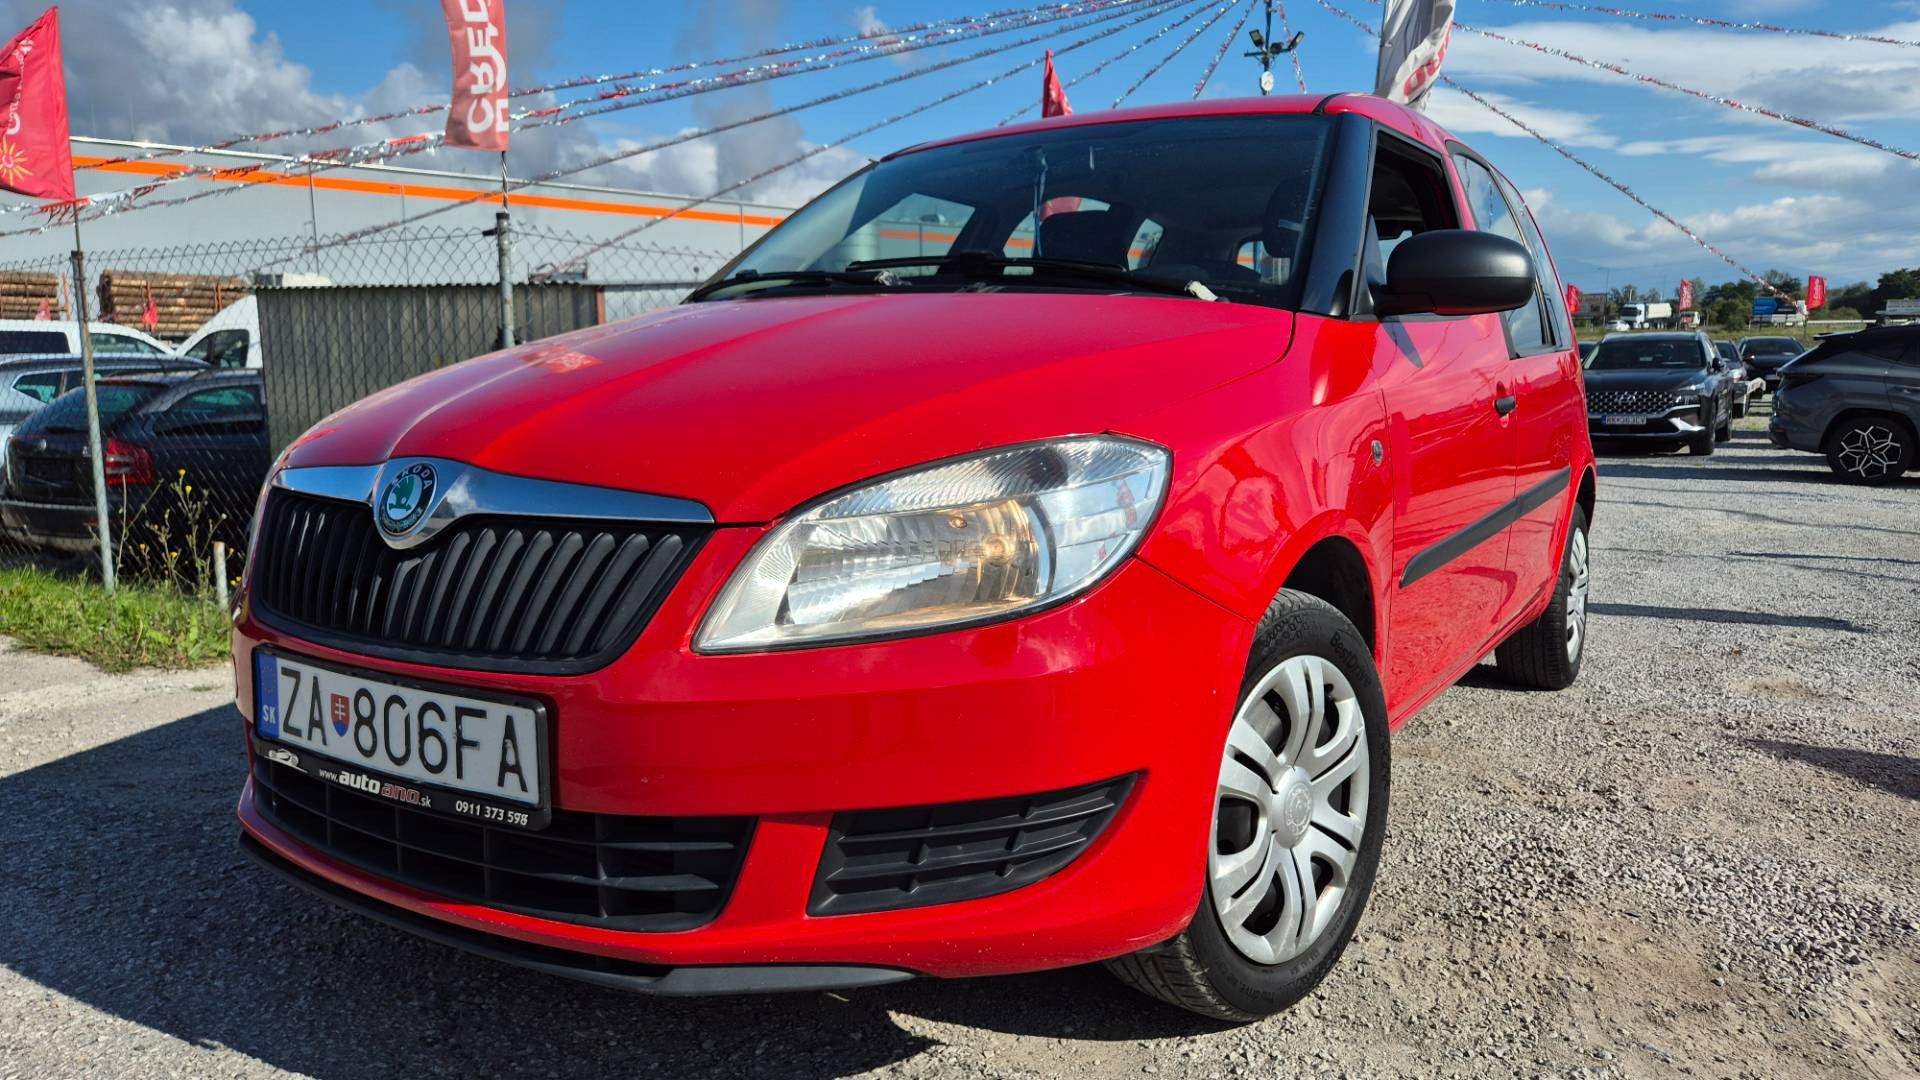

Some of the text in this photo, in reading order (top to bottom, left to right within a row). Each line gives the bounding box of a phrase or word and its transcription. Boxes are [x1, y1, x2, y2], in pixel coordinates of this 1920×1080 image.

[262, 704, 276, 725] SK
[281, 667, 528, 793] ZA 806FA
[455, 800, 481, 816] 0911
[484, 805, 505, 821] 373
